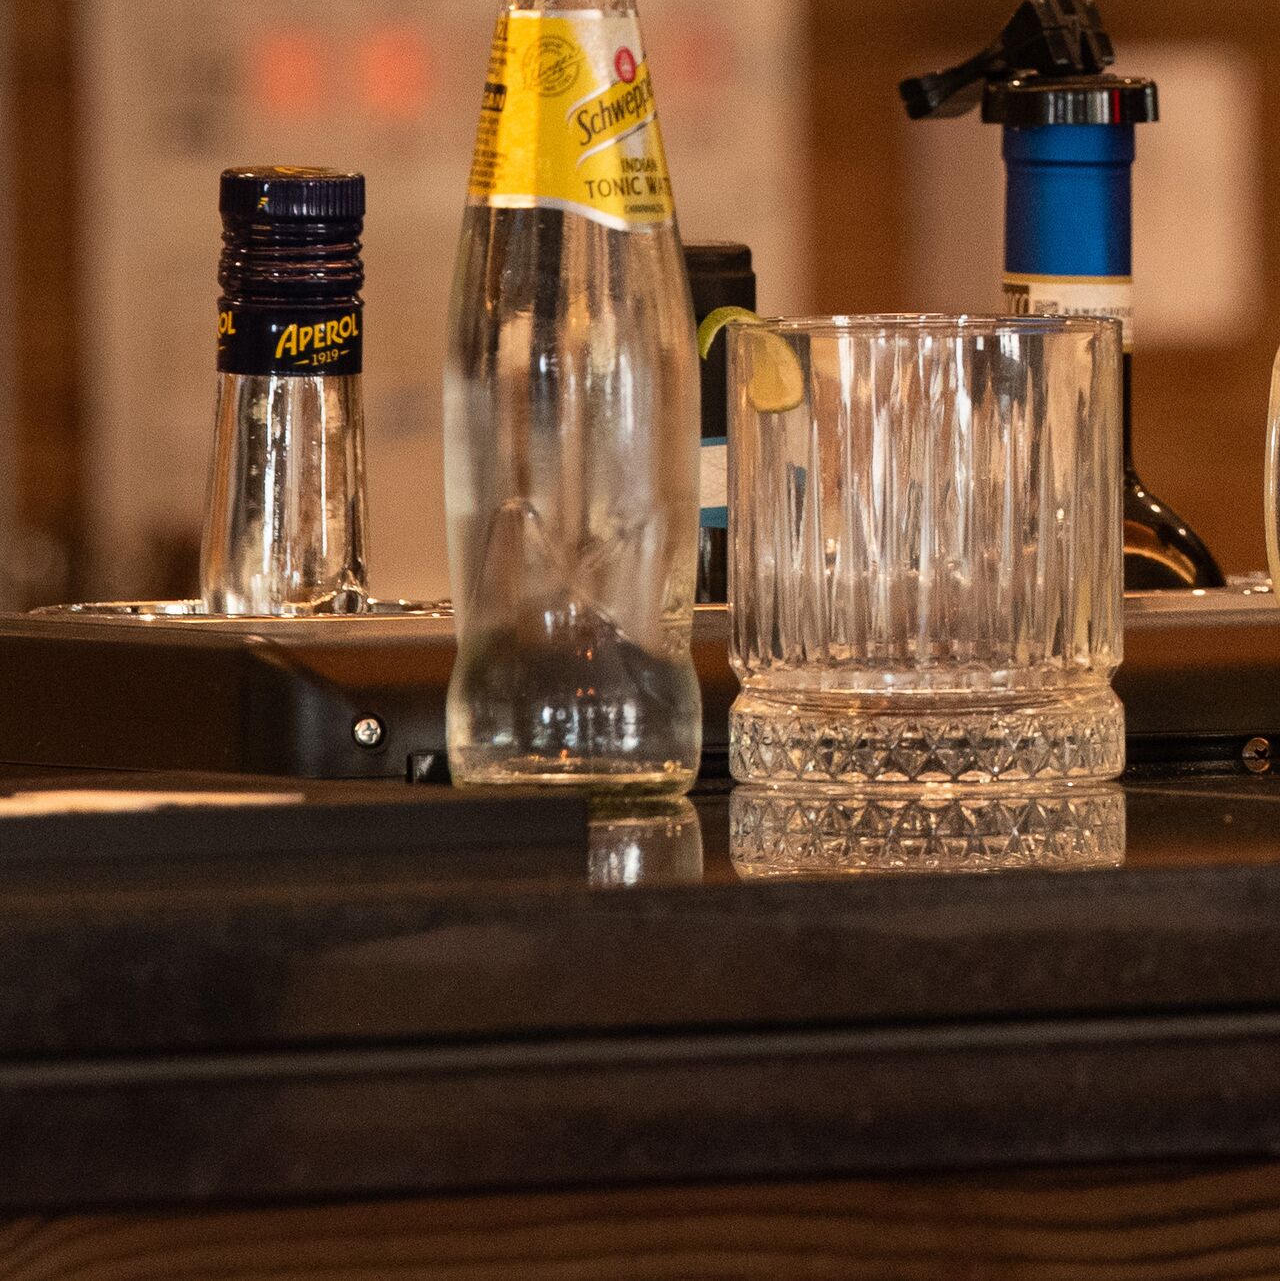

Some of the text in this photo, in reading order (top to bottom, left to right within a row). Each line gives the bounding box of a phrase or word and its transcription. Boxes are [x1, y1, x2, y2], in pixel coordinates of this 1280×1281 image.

[576, 71, 653, 146] Schwepp
[584, 176, 643, 199] TONIC
[275, 313, 359, 359] APEROL
[312, 349, 339, 366] 1919
